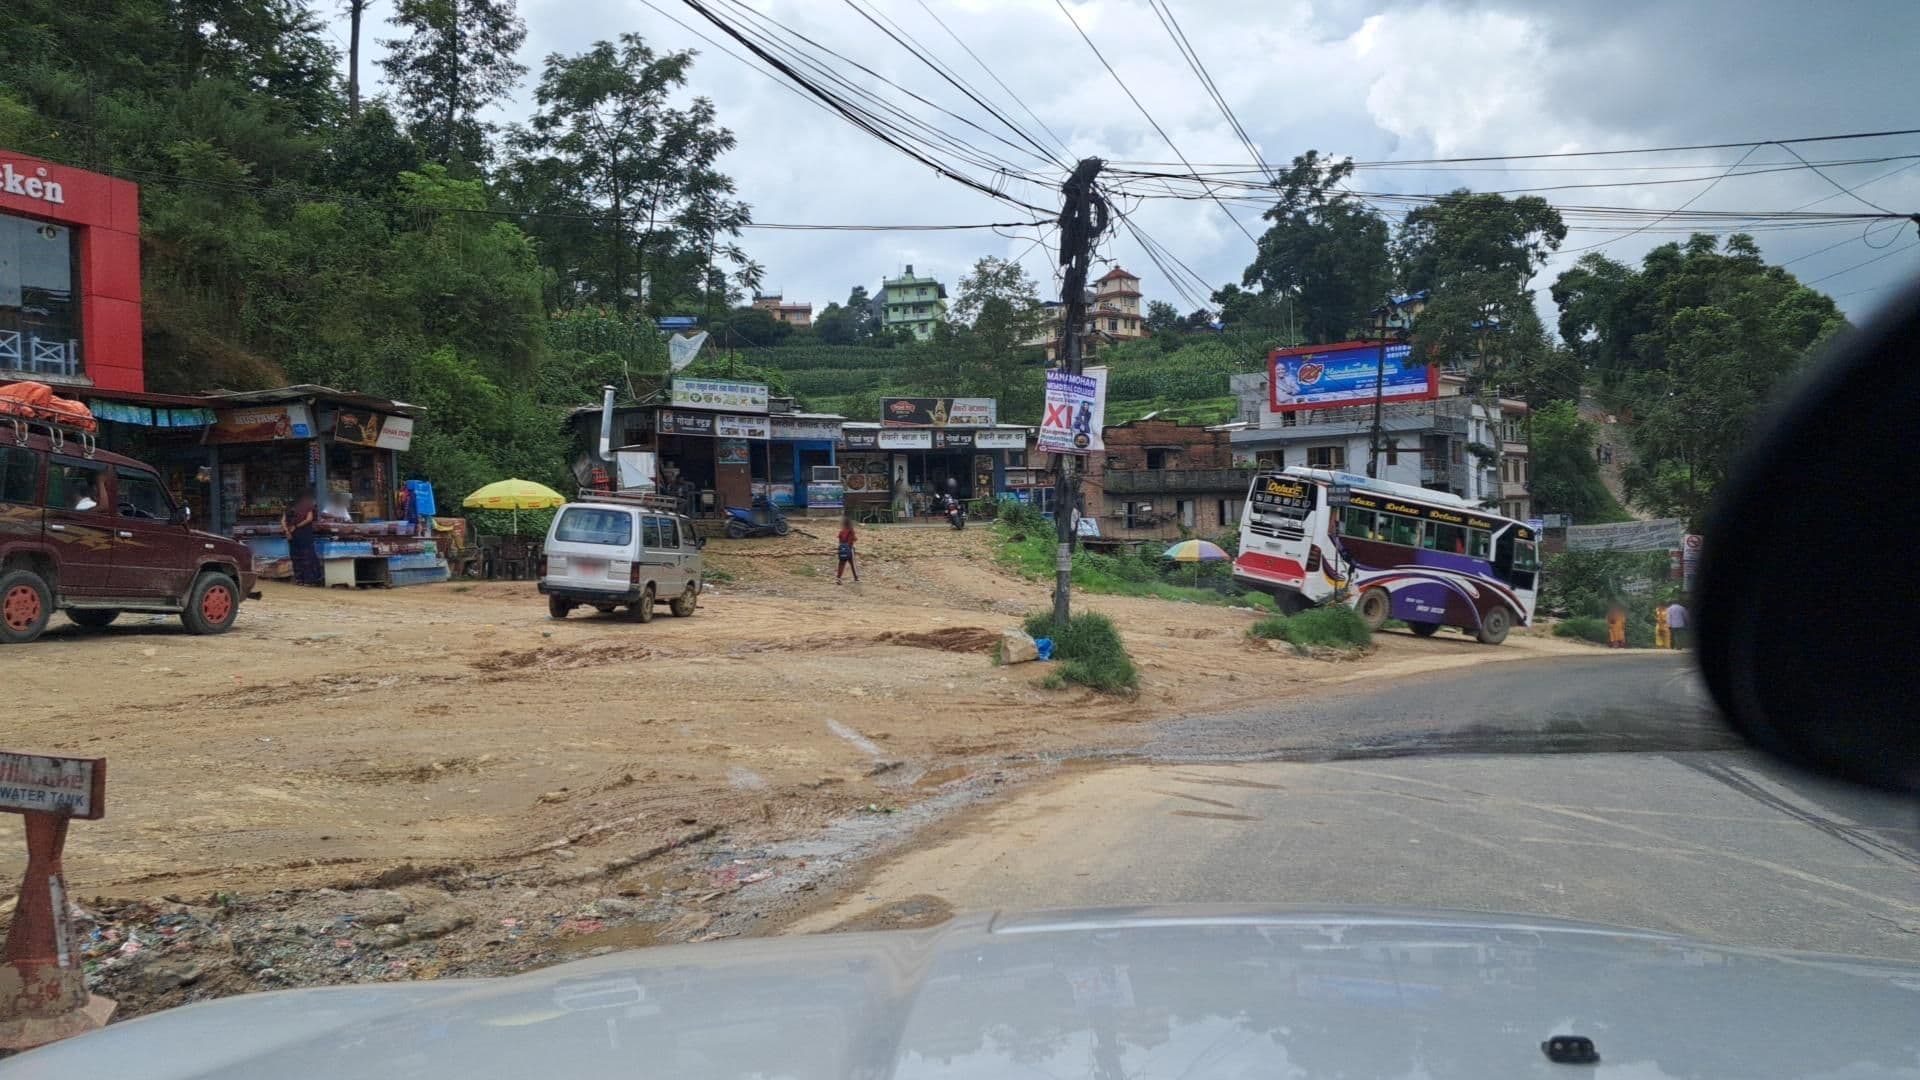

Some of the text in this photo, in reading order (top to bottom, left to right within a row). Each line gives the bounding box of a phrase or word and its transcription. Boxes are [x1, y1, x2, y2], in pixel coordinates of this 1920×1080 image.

[1043, 402, 1073, 430] XI
[1384, 502, 1420, 516] Deluxe
[1428, 510, 1462, 523] Deluxe
[0, 785, 84, 807] WATER TANK
